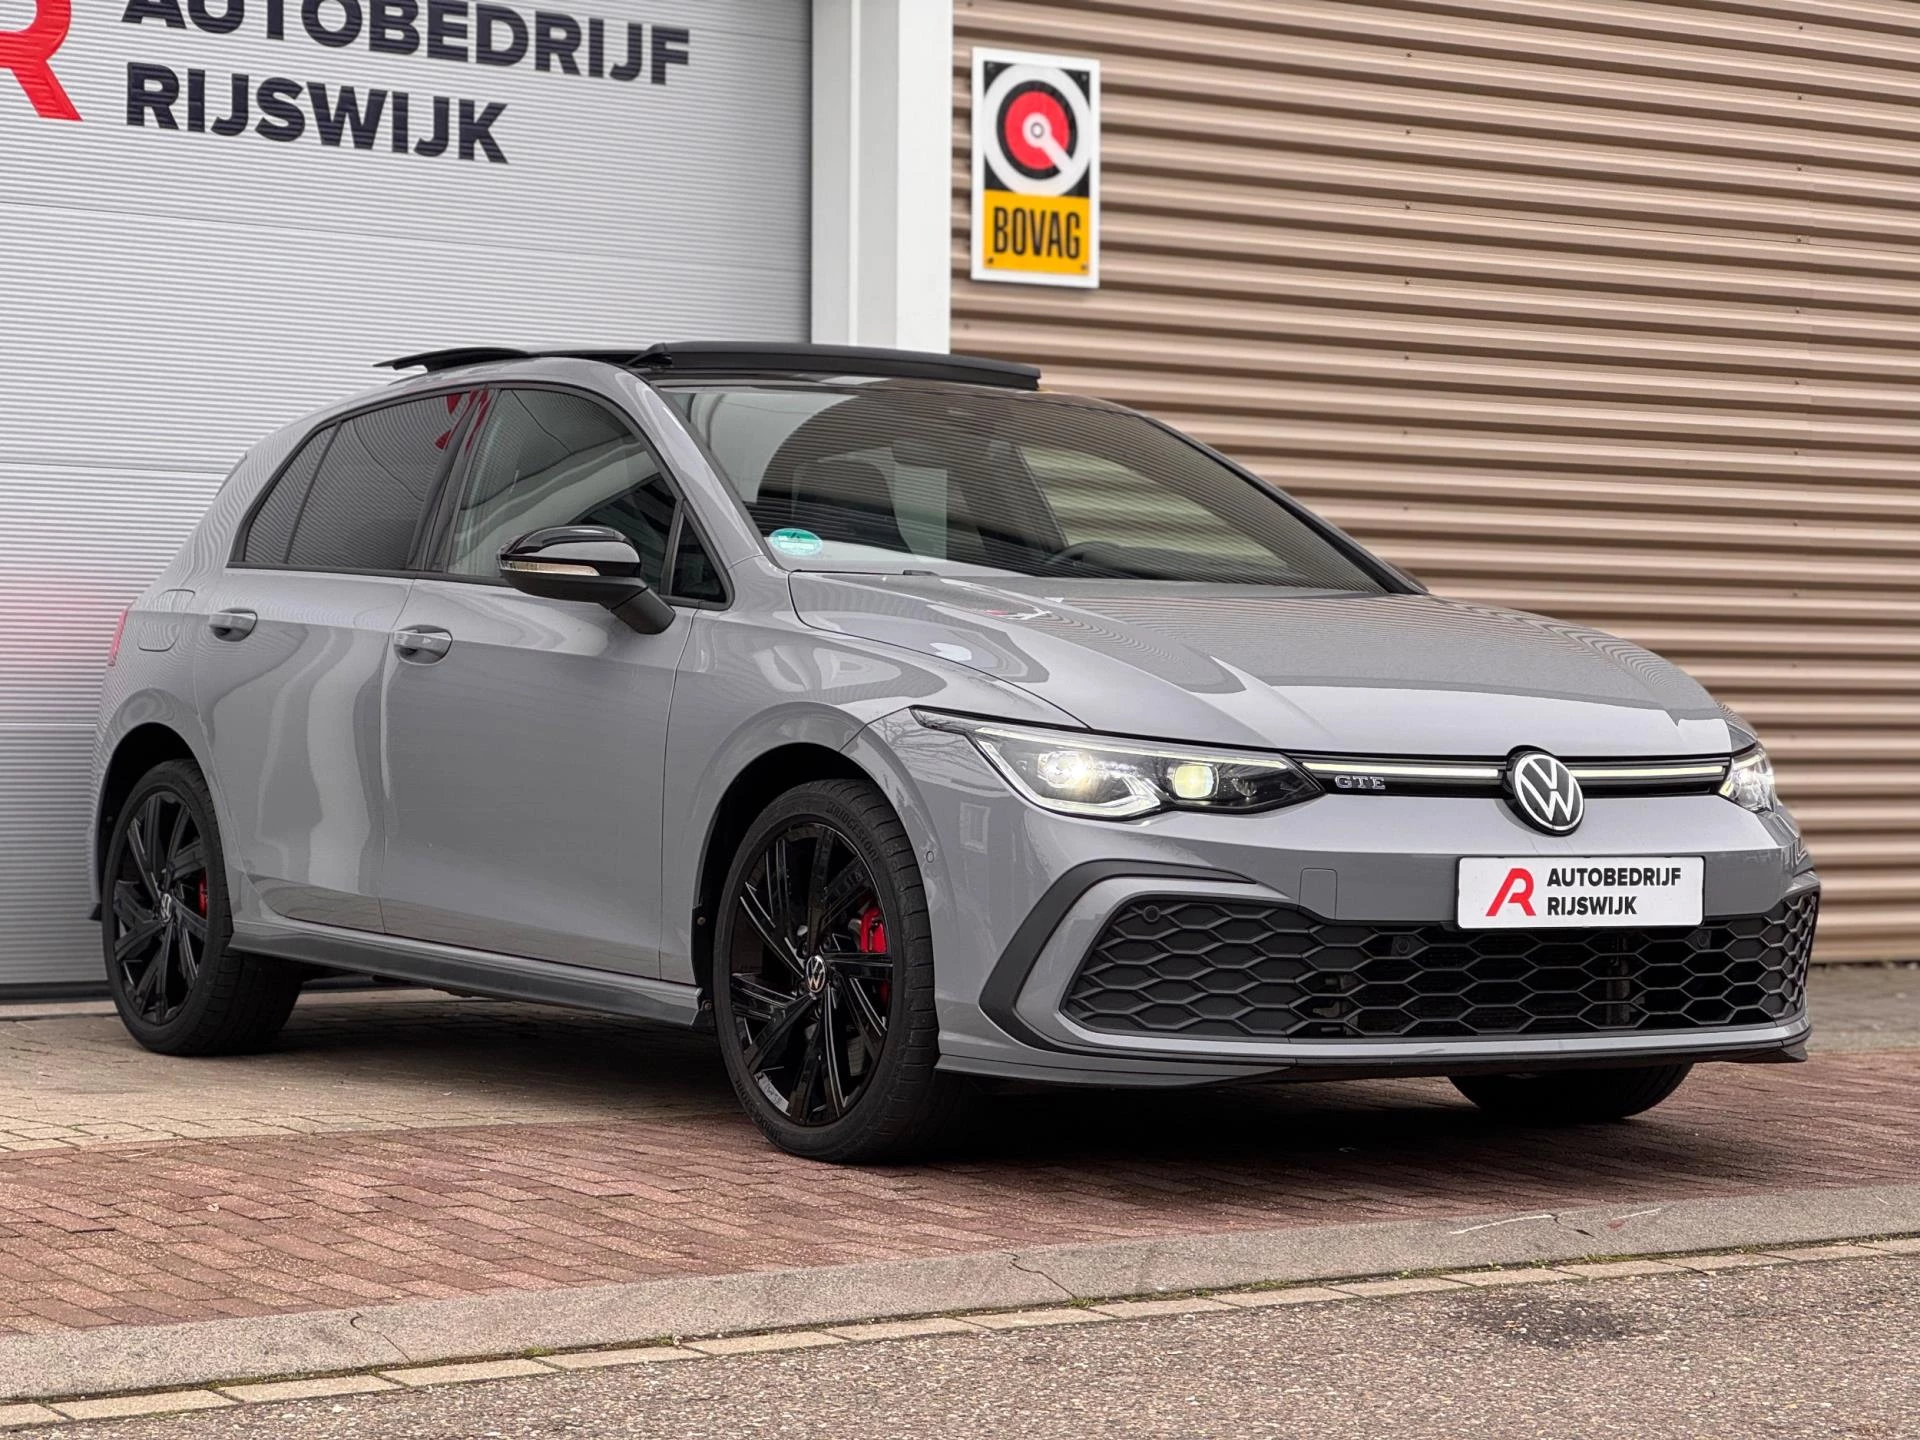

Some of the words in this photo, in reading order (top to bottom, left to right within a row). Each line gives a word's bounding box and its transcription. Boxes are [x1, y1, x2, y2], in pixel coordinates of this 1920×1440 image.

[126, 61, 510, 165] RIJSWIJK
[993, 206, 1080, 260] BOVAG
[1334, 775, 1387, 791] GTE
[1546, 867, 1682, 888] AUTOBEDRIJF
[1546, 896, 1638, 916] RIJSWIJK
